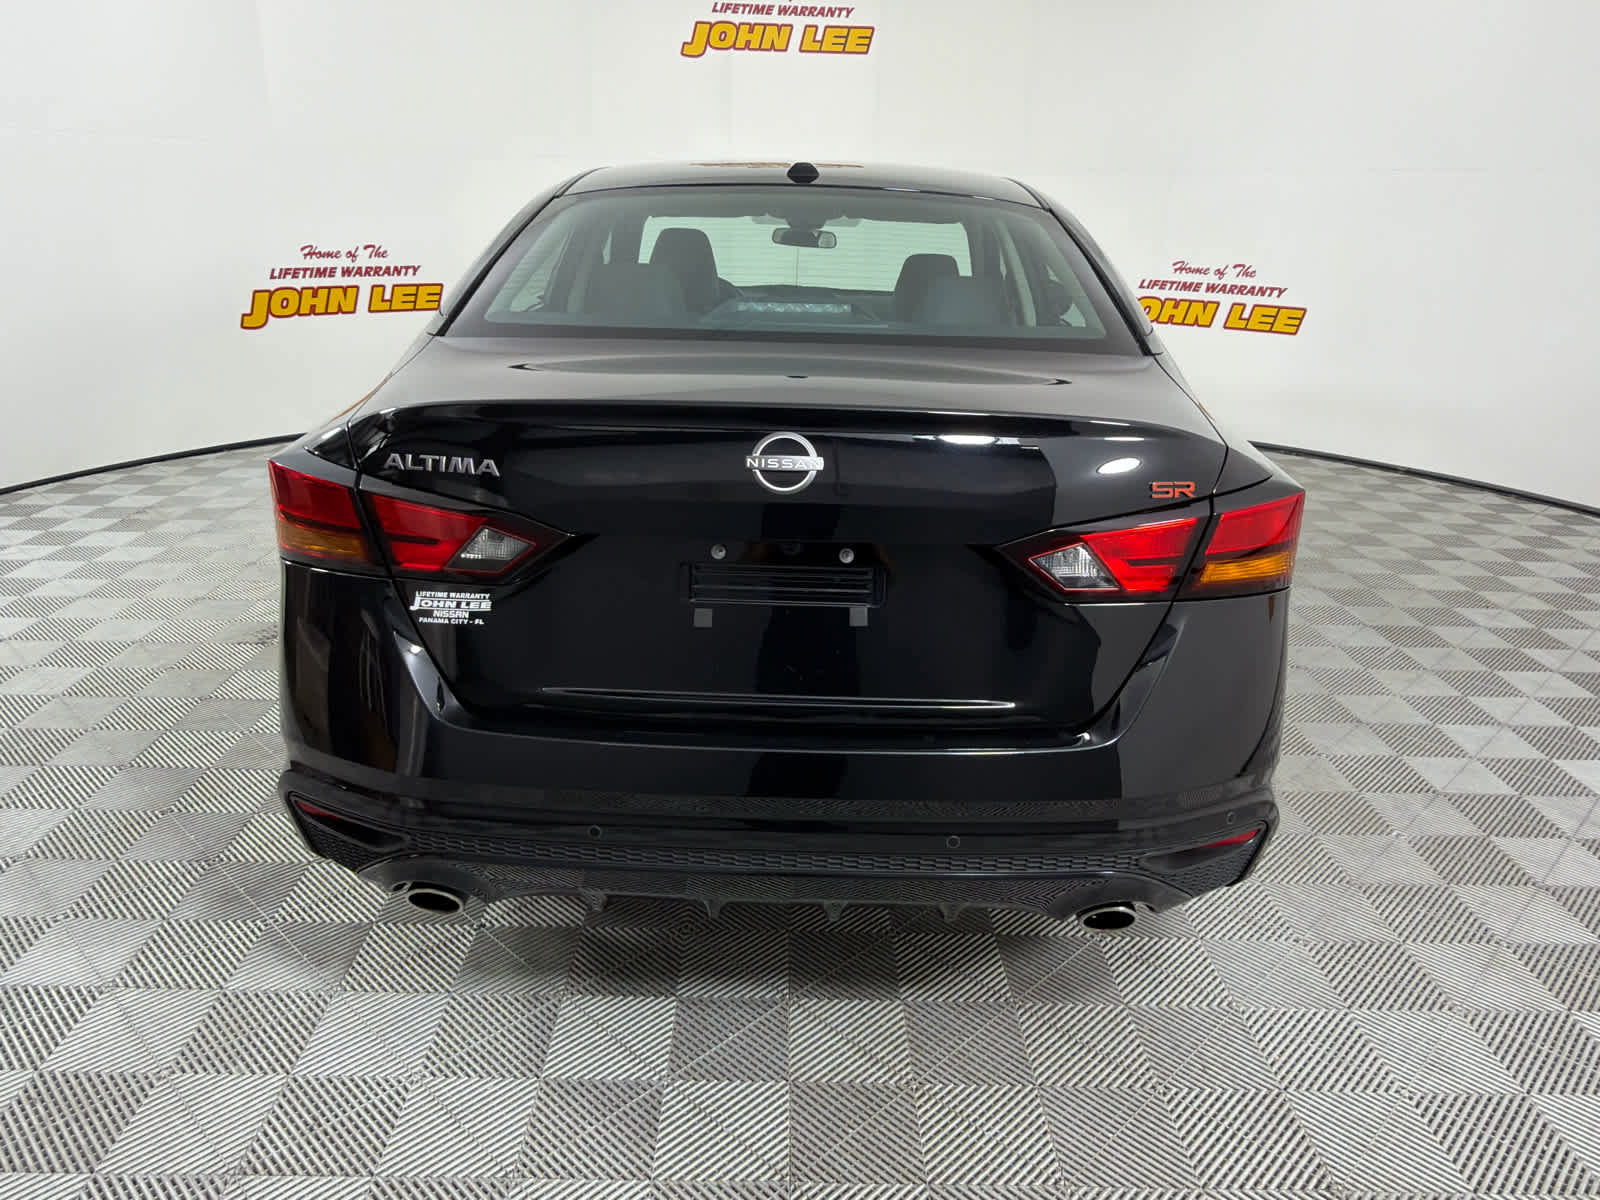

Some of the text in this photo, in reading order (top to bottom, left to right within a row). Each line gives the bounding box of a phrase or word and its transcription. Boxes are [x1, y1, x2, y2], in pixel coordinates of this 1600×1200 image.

[712, 2, 855, 18] LIFETIME WARRANTY
[680, 21, 875, 58] JOHN LEE
[300, 244, 389, 263] Home of The
[269, 265, 421, 280] LIFETIME WARRANTY
[1172, 260, 1257, 281] Home of The
[1138, 279, 1288, 299] LIFETIME WARRANTY
[240, 283, 444, 330] JOHN LEE
[1137, 296, 1307, 335] OHN LEE
[384, 453, 500, 476] ALTIMA
[746, 457, 822, 470] NISSAN
[1150, 481, 1196, 498] SR
[409, 597, 492, 611] JOHN LEE
[433, 610, 469, 618] NISSAN
